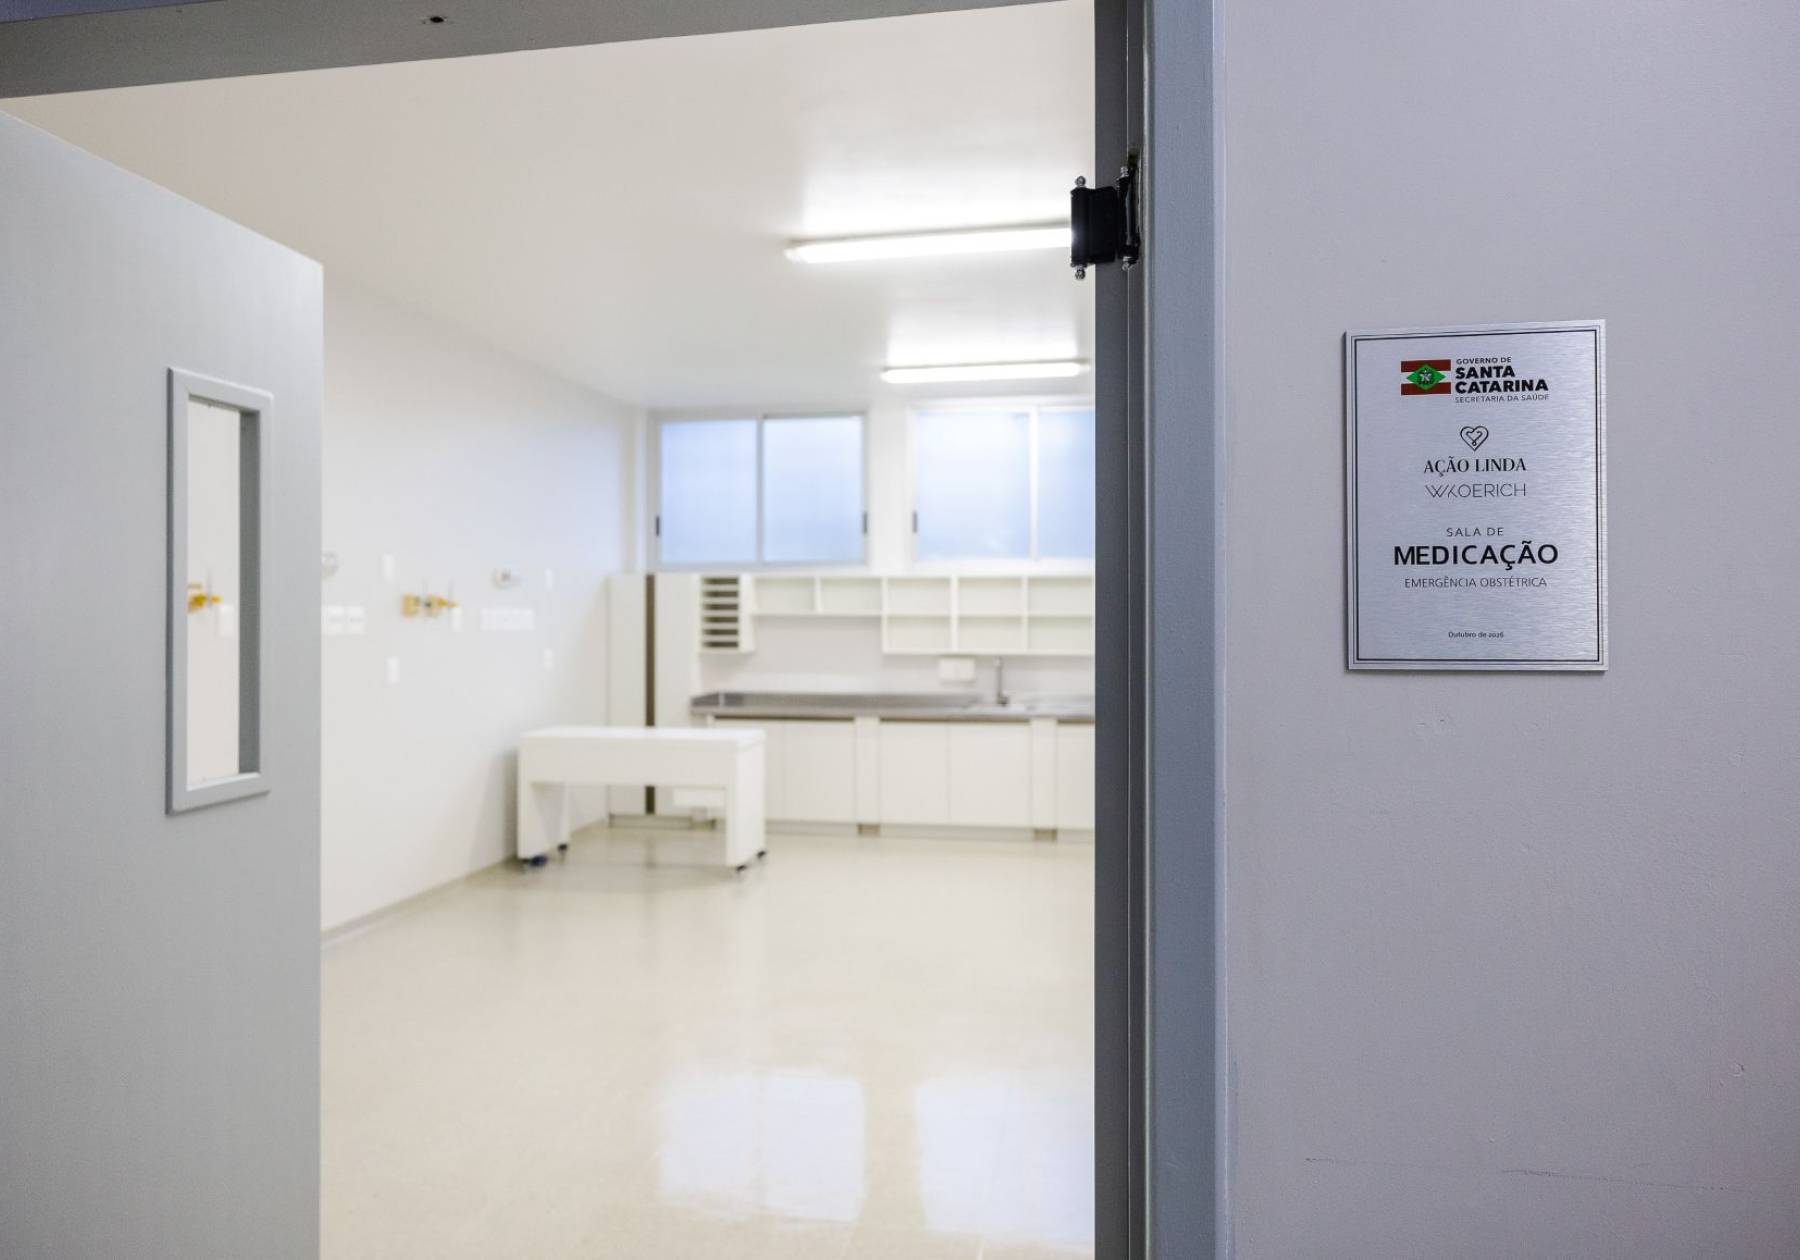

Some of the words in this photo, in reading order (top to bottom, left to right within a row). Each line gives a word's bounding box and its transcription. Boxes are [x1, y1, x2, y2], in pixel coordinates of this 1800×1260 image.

[1456, 357, 1498, 365] GOVERNO
[1500, 356, 1512, 364] DE
[1455, 365, 1515, 379] SANTA
[1455, 379, 1549, 394] CATARINA
[1455, 395, 1504, 404] SECRETARIA
[1521, 393, 1549, 401] SAÚDE
[1423, 456, 1470, 477] AÇÃO
[1475, 457, 1527, 472] LINDA
[1446, 527, 1482, 537] SALA
[1486, 527, 1504, 536] DE
[1394, 540, 1558, 571] MEDICAÇÃO
[1404, 576, 1477, 589] EMERGÊNCIA
[1480, 575, 1548, 588] OBSTÉTRICA
